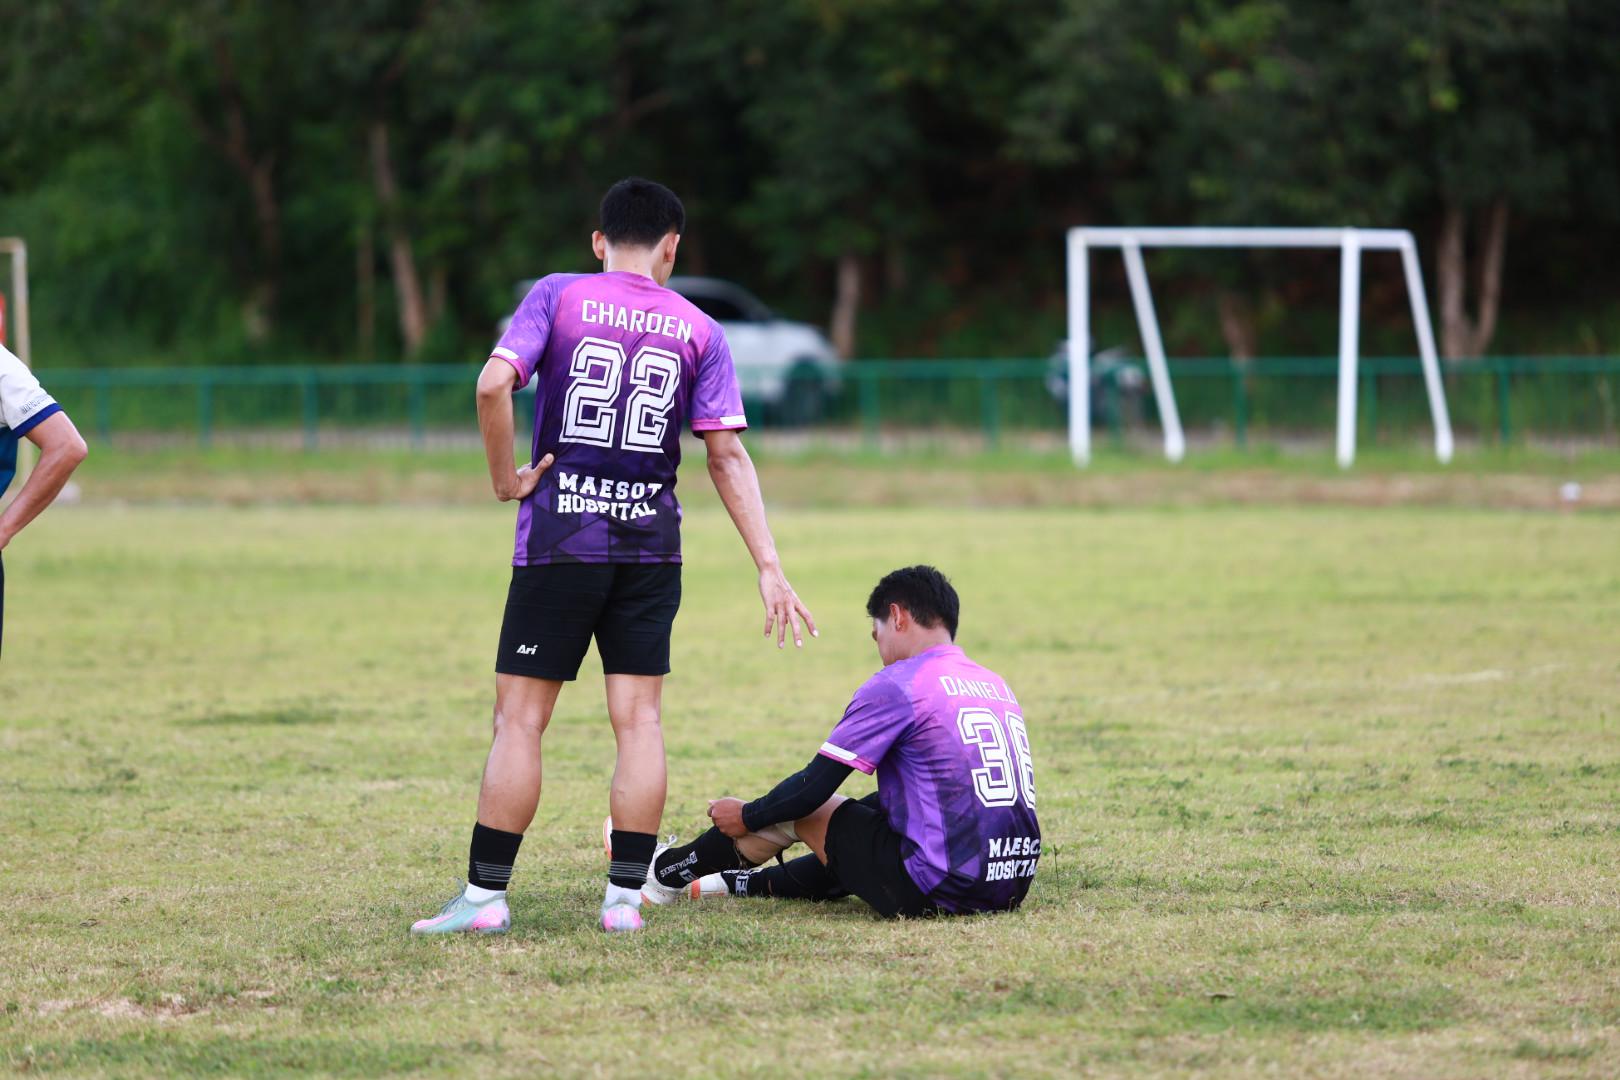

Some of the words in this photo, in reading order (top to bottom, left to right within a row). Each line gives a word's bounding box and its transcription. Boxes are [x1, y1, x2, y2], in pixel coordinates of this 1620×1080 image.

[558, 336, 681, 454] 22
[558, 472, 662, 500] MAESOT
[557, 494, 657, 521] HOSPITAL
[516, 644, 539, 655] Ari
